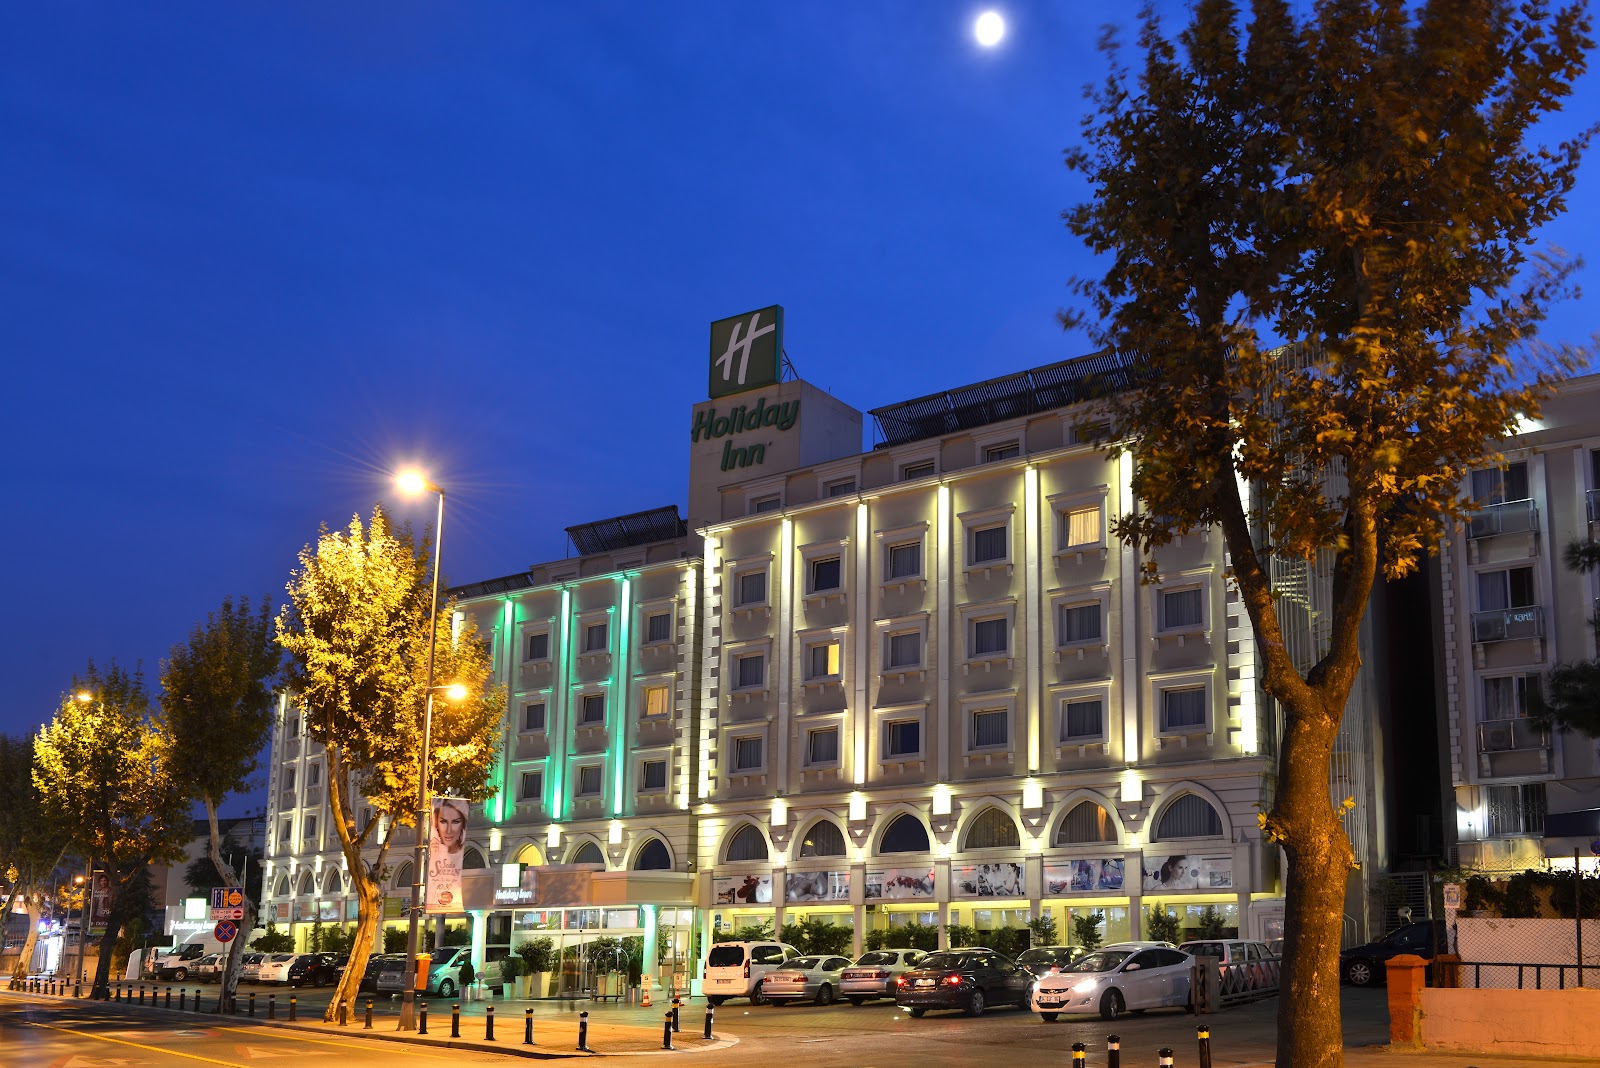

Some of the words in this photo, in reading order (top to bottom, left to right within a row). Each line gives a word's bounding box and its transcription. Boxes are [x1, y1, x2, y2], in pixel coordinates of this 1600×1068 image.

[691, 397, 801, 443] Holiday
[720, 439, 766, 472] Inn
[495, 889, 520, 901] Holiday
[519, 889, 532, 899] Inn
[171, 920, 203, 932] Holiday
